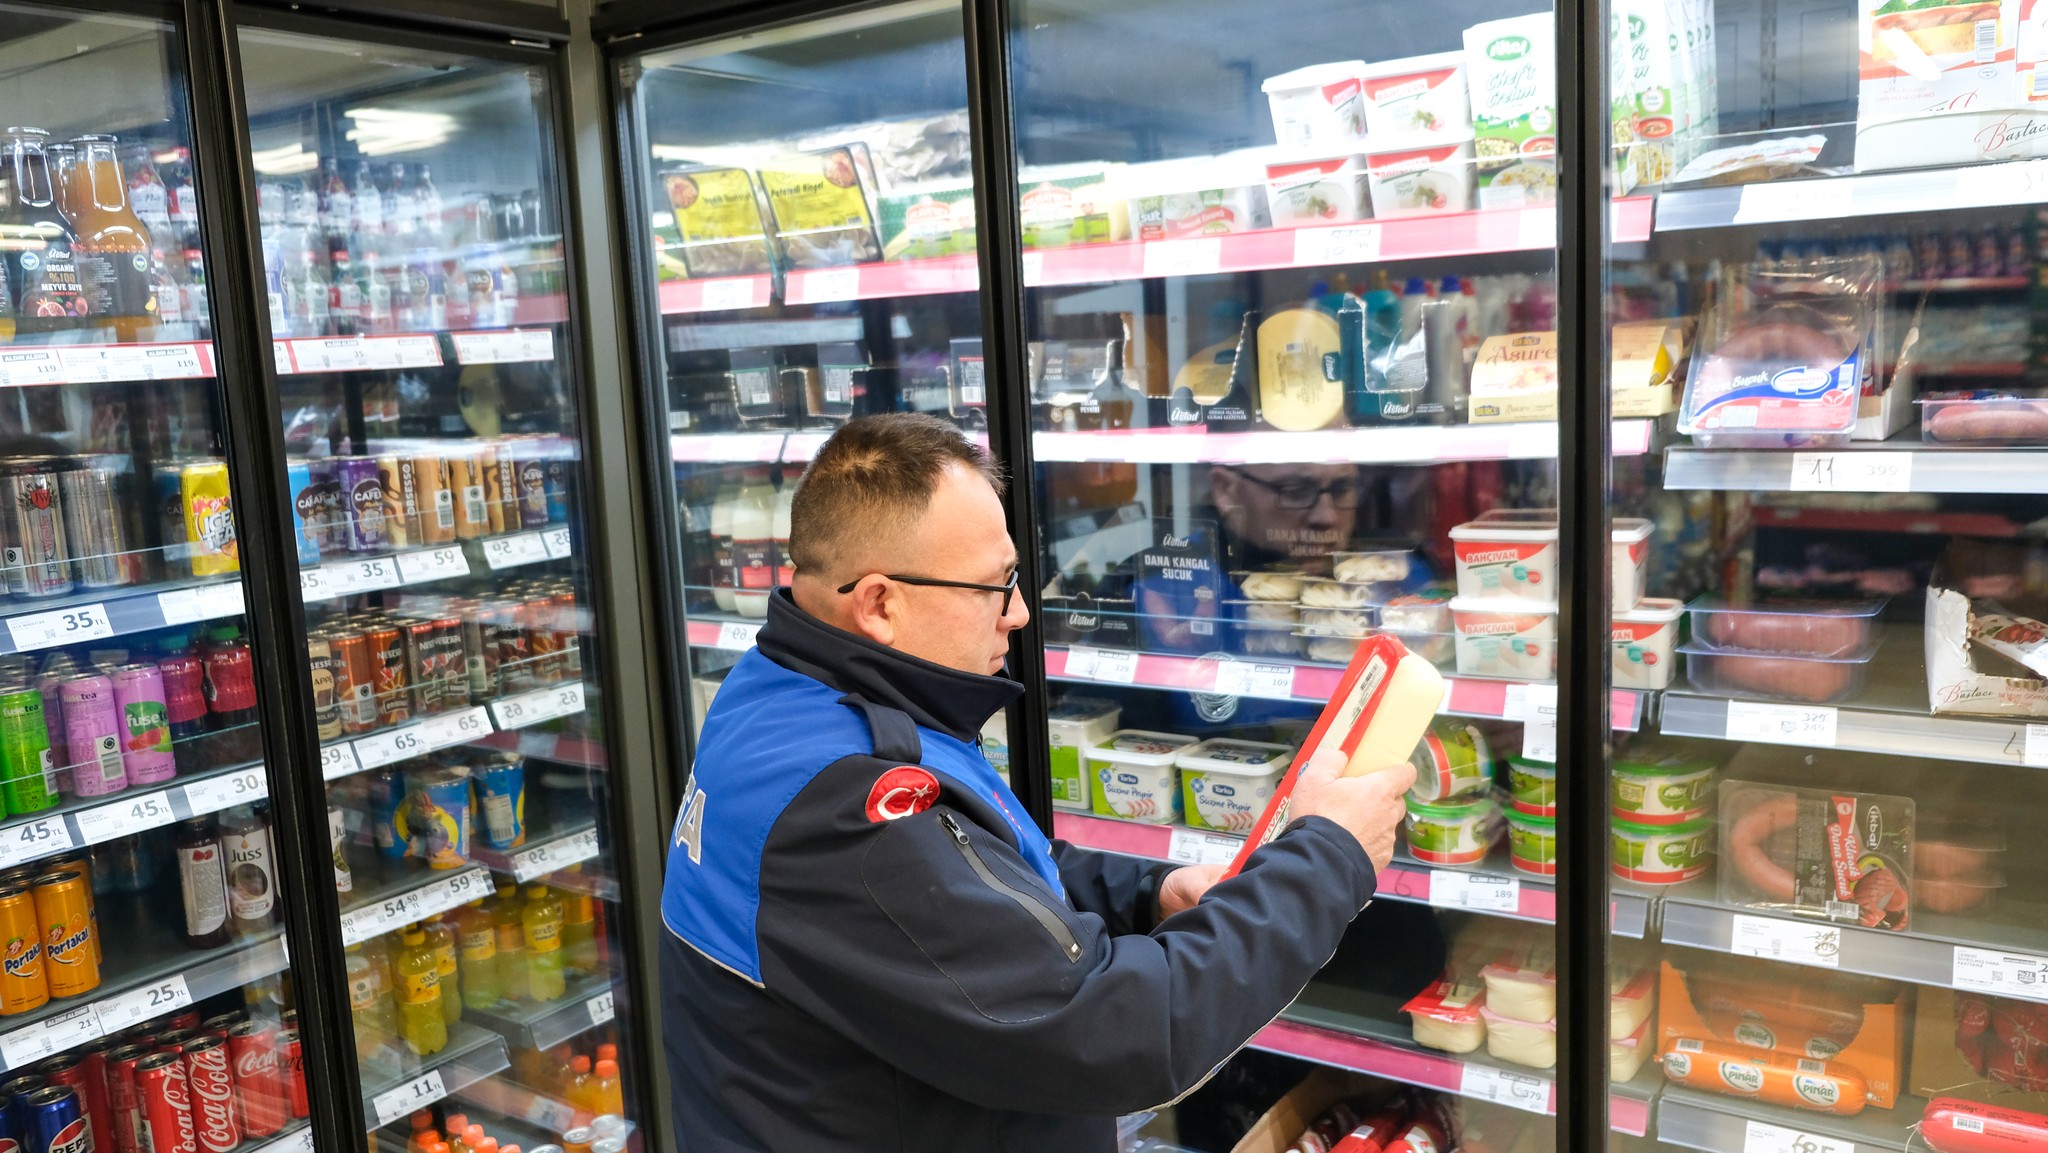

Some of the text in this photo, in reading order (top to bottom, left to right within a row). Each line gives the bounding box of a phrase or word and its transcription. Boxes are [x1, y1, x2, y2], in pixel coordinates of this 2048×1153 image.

[1170, 407, 1199, 422] Üstad
[1383, 401, 1410, 415] Üstad
[203, 508, 232, 533] ICE
[1162, 533, 1189, 548] Üstad
[434, 550, 455, 566] 59
[1144, 554, 1210, 571] DANA KANGAL
[361, 562, 384, 578] 35
[1162, 567, 1193, 581] SUCUK
[62, 611, 94, 631] 35
[1069, 611, 1097, 627] Üstad
[1272, 678, 1289, 687] 109
[458, 714, 480, 731] 65
[394, 733, 417, 750] 65
[232, 775, 260, 794] 30
[1119, 774, 1138, 784] Torku
[1106, 783, 1154, 800] Süzme Peynir
[1214, 786, 1234, 797] Torku
[130, 800, 170, 820] 45 TL
[1199, 796, 1252, 813] Süzme Peynir
[20, 821, 64, 843] 45 TL
[333, 825, 346, 838] Ju
[231, 847, 262, 863] Juss
[1225, 851, 1236, 859] 15
[1830, 824, 1851, 897] Dana Sucuk
[1843, 835, 1861, 879] Klasik
[1494, 889, 1512, 899] 189
[47, 926, 89, 959] Portakal
[147, 983, 186, 1007] 25 TL
[412, 1079, 434, 1099] 11
